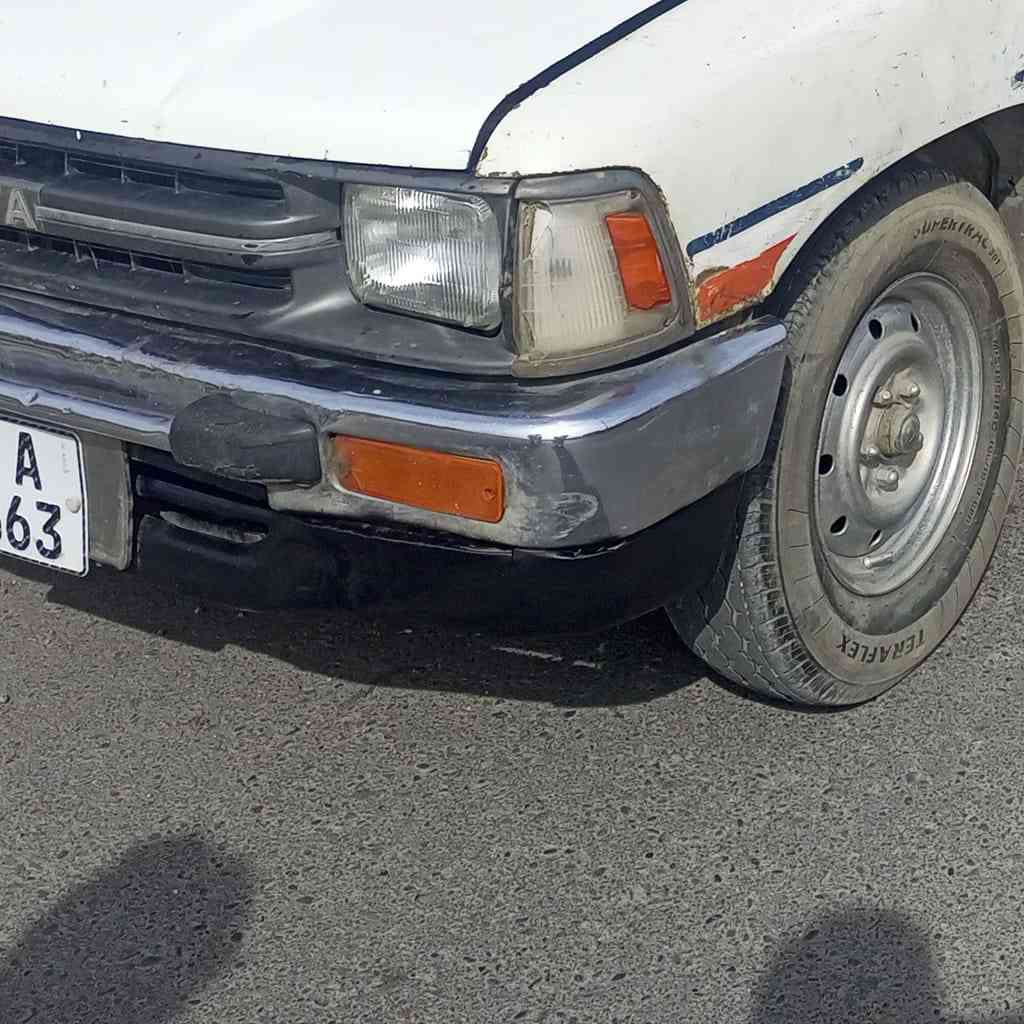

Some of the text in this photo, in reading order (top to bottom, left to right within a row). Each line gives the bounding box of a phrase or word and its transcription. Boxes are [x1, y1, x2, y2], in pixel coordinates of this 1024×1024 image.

[15, 431, 42, 491] A
[0, 495, 62, 560] 63
[836, 629, 925, 663] TERAFLEX
